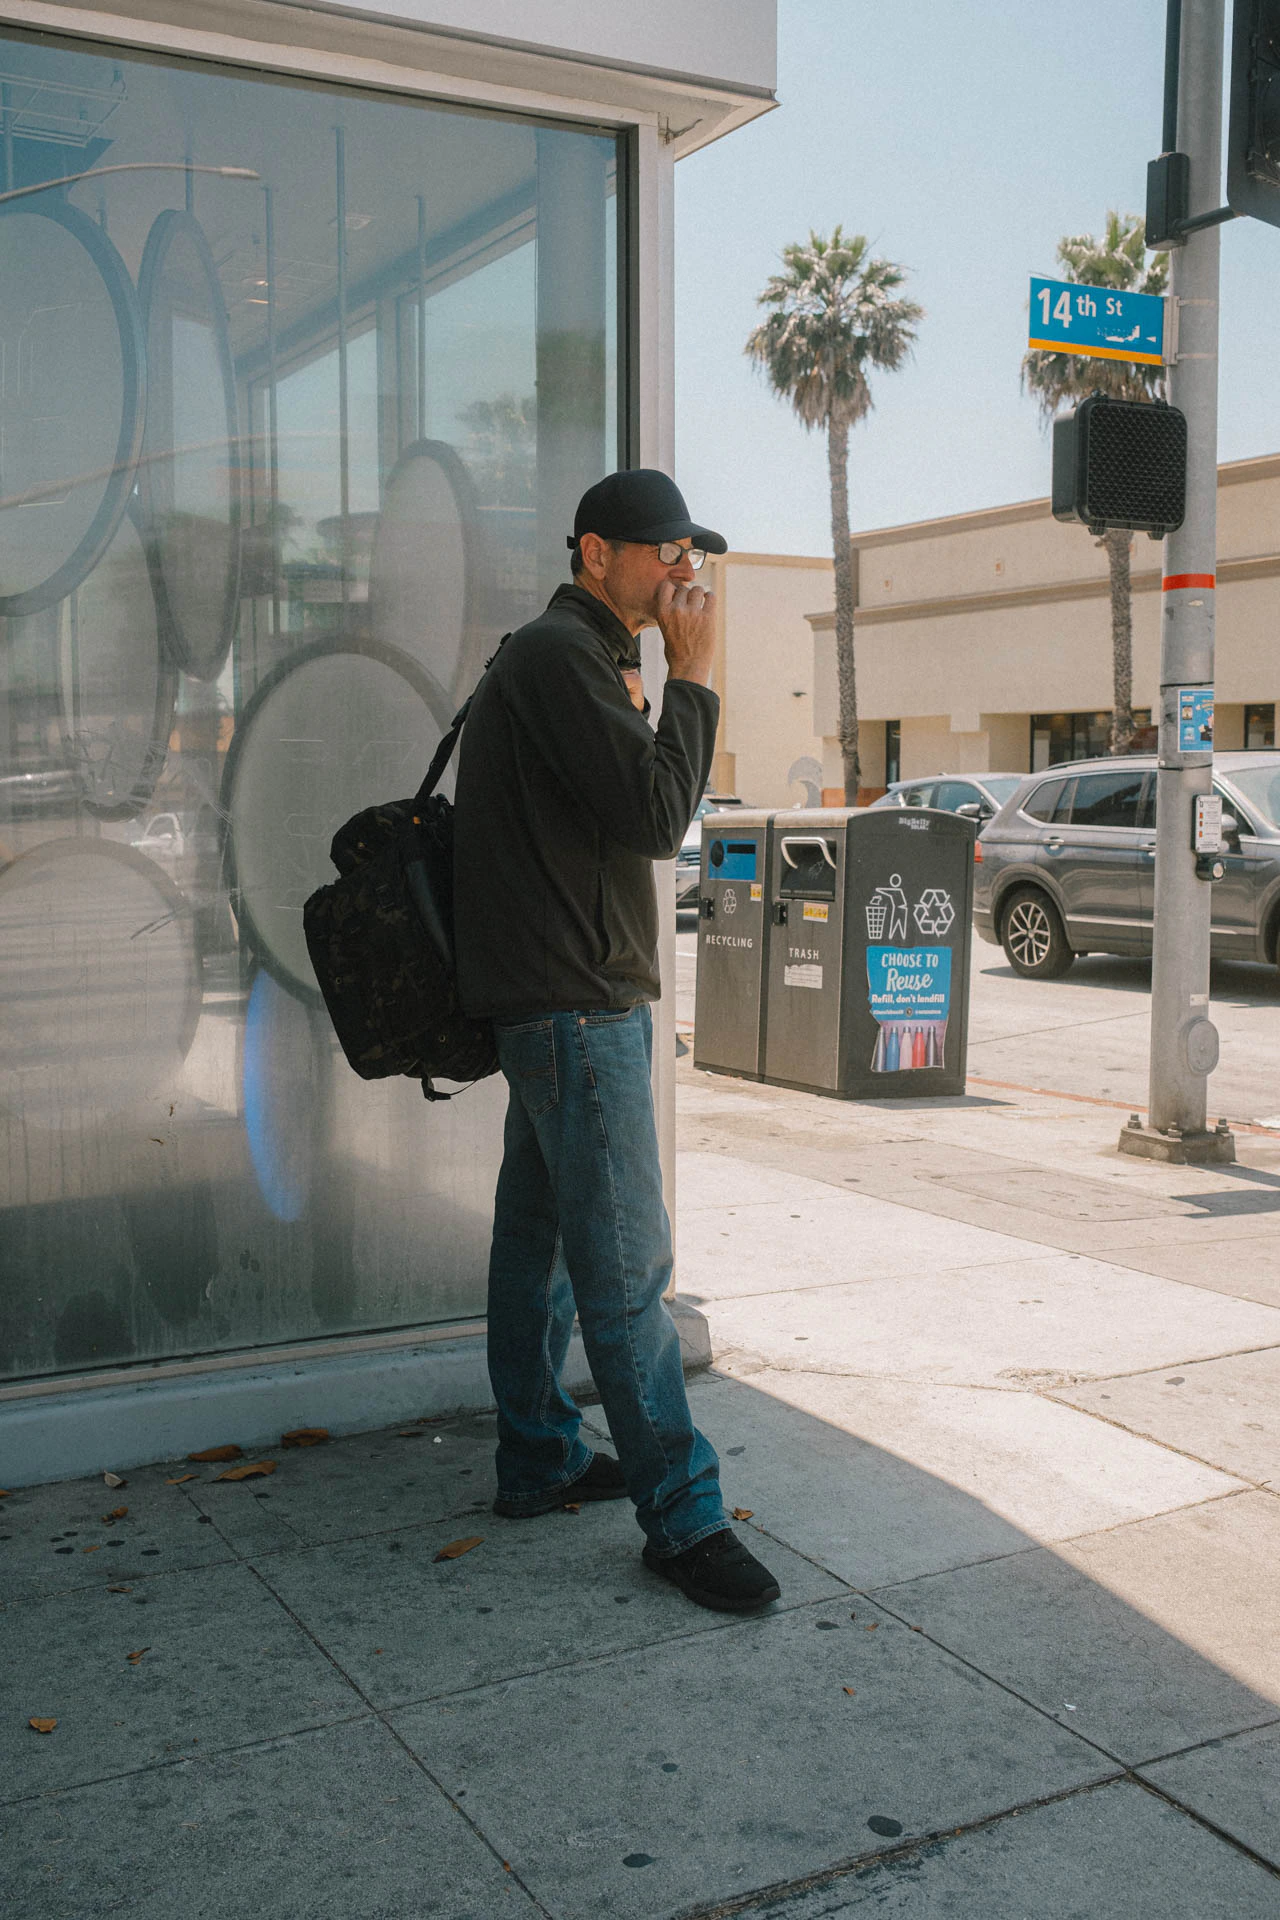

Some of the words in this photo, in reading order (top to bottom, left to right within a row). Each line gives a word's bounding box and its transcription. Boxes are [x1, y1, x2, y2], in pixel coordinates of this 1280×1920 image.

[1037, 288, 1097, 328] 14th
[1106, 297, 1123, 316] St
[705, 934, 753, 949] RECYCLING
[788, 947, 820, 960] TRASH
[881, 953, 923, 968] CHOOSE
[925, 953, 939, 968] TO
[886, 968, 933, 992] Reuse
[871, 994, 895, 1004] Refill,
[896, 994, 916, 1003] don't
[917, 994, 945, 1003] landfill
